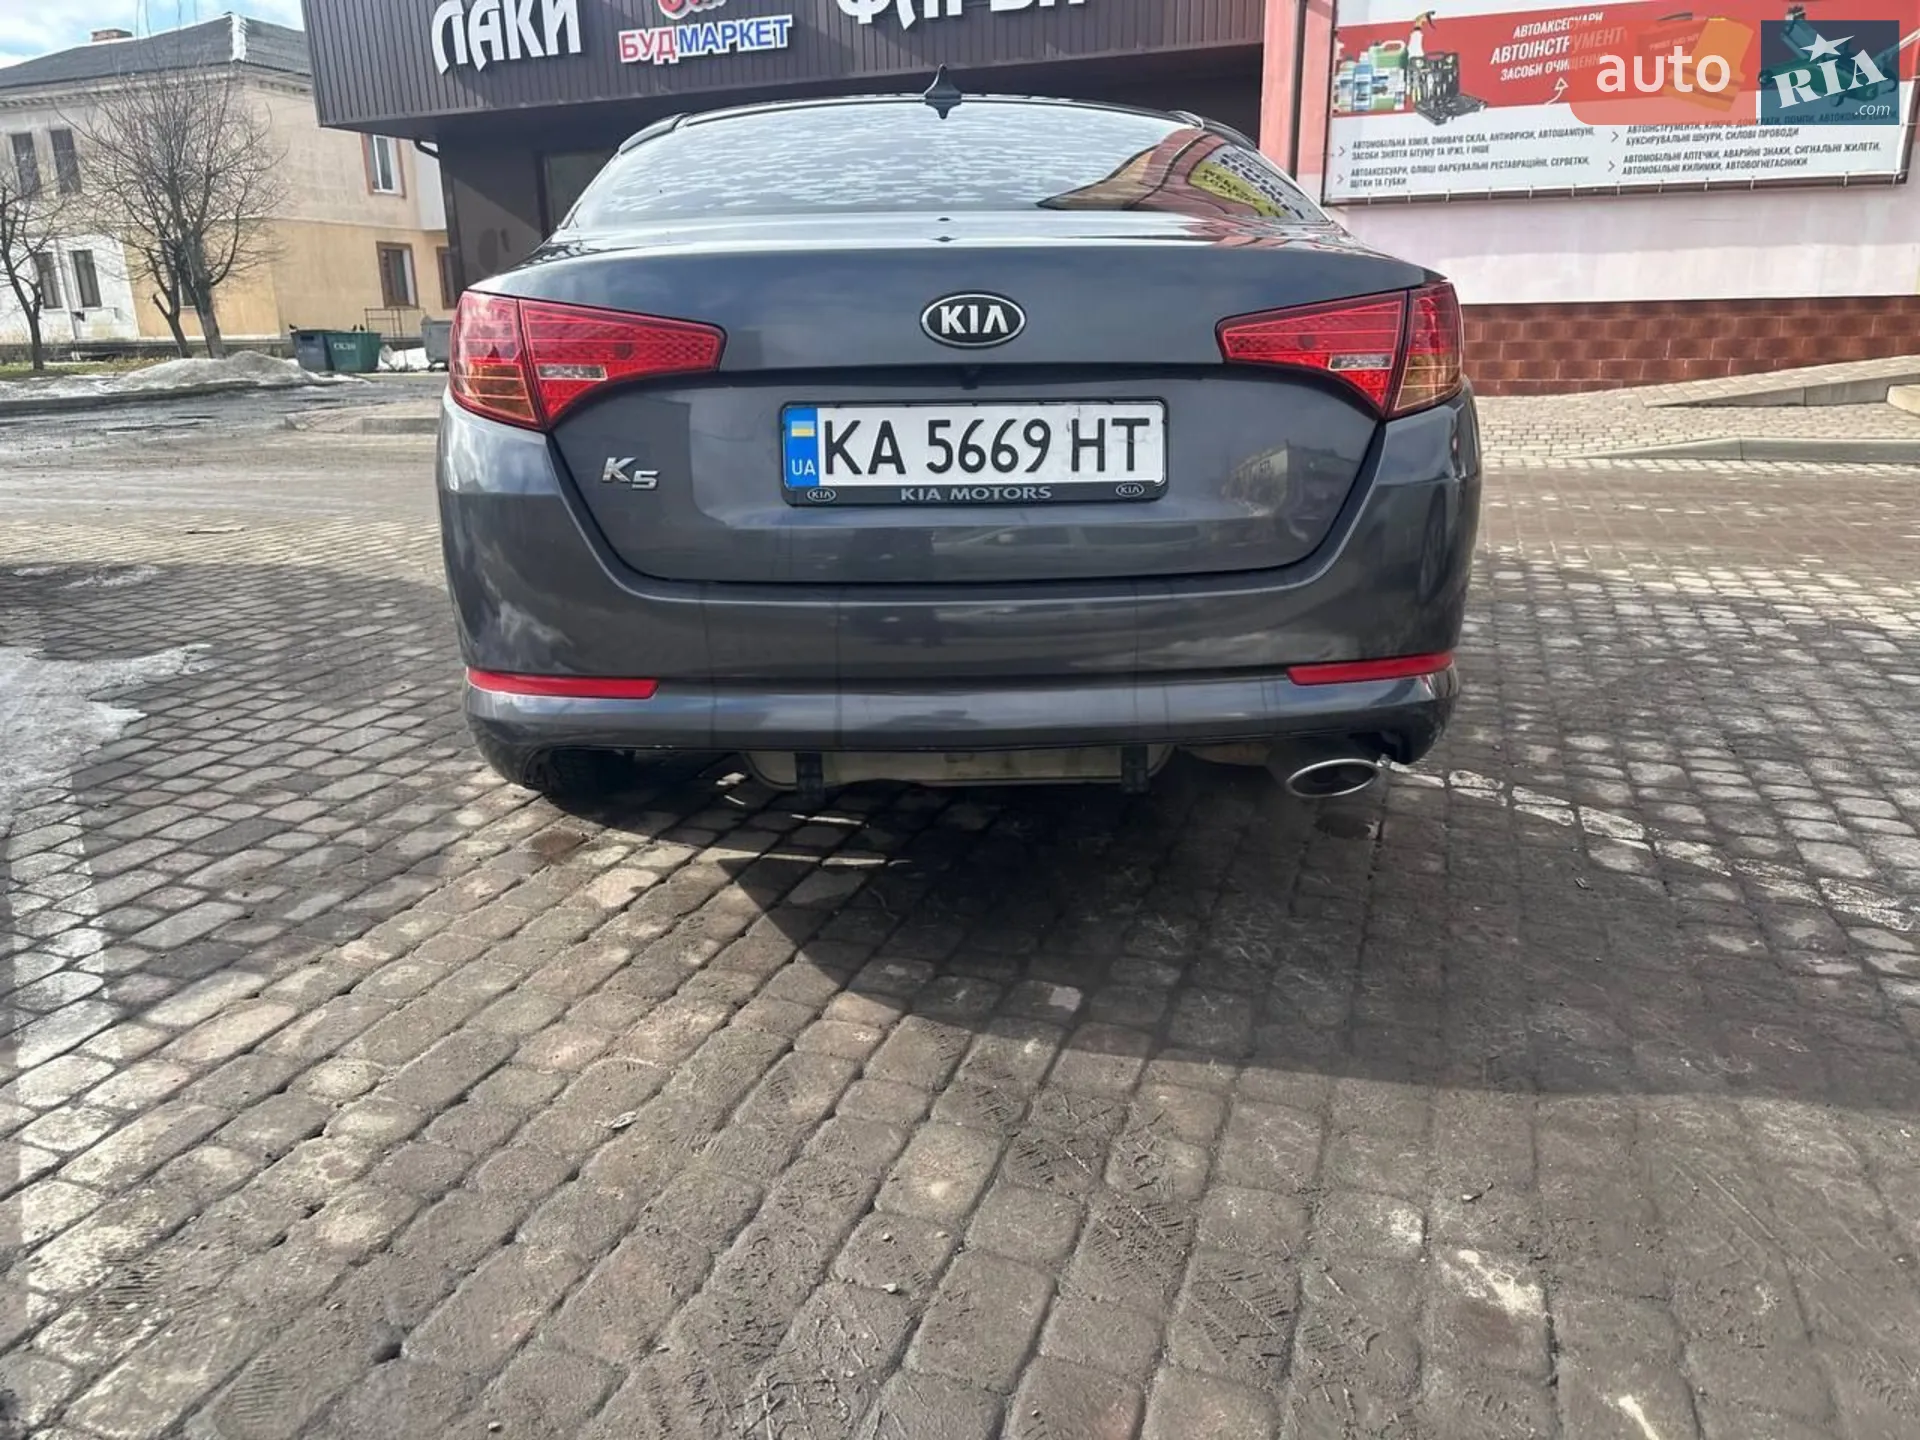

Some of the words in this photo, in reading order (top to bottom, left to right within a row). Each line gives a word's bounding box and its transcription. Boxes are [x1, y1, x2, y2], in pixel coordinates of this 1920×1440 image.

[431, 0, 581, 75] ЛАКИ
[619, 16, 791, 63] БУДМАРКЕТ
[1512, 12, 1604, 40] АВТОАКСЕСУАРИ
[1500, 62, 1543, 82] ЗАСОБИ
[939, 304, 1009, 334] KIA
[824, 419, 907, 475] KA
[926, 418, 1052, 474] 5669
[1070, 417, 1150, 473] HT
[602, 456, 660, 490] K5
[791, 459, 817, 476] UA
[811, 489, 831, 499] KIA
[900, 487, 942, 501] KIA
[950, 486, 1053, 501] MOTORS
[1120, 485, 1141, 495] KIA
